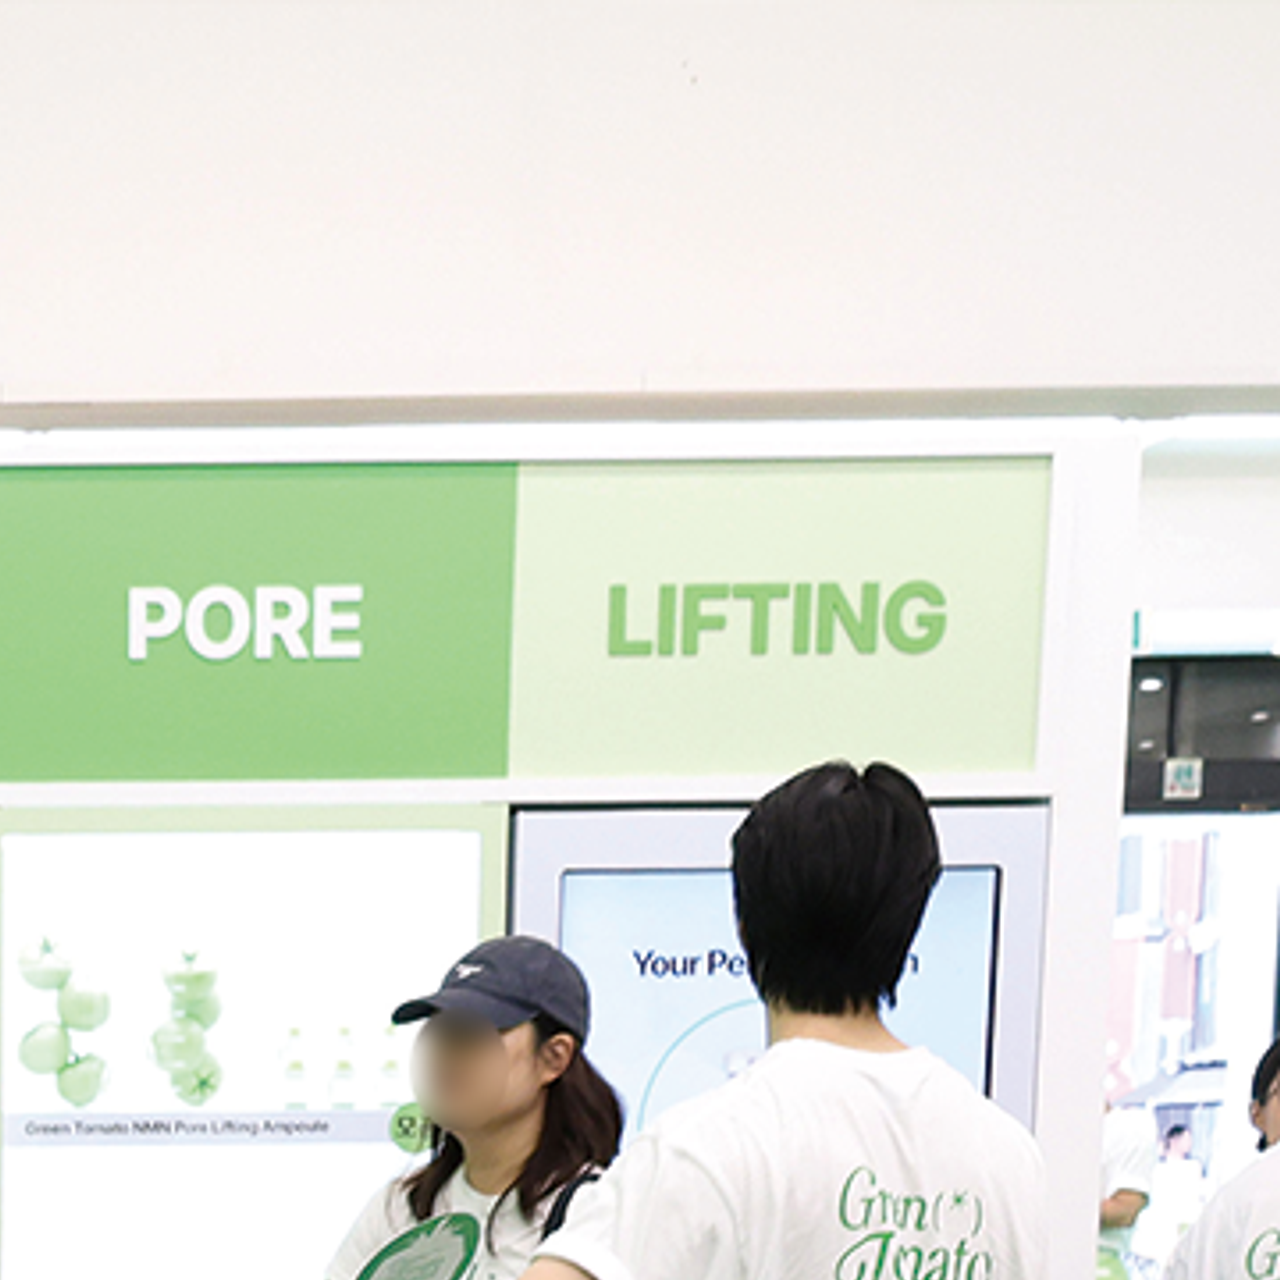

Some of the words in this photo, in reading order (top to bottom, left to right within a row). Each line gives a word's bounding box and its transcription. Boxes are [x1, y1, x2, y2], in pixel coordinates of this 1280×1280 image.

[127, 584, 364, 661] PORE
[607, 579, 948, 658] LIFTING
[632, 949, 702, 978] Your
[24, 1120, 72, 1136] Green
[74, 1119, 129, 1135] Tomato
[131, 1118, 172, 1134] NMN
[174, 1119, 207, 1134] Pore
[211, 1119, 258, 1136] Lifting
[263, 1118, 329, 1134] Ampoule
